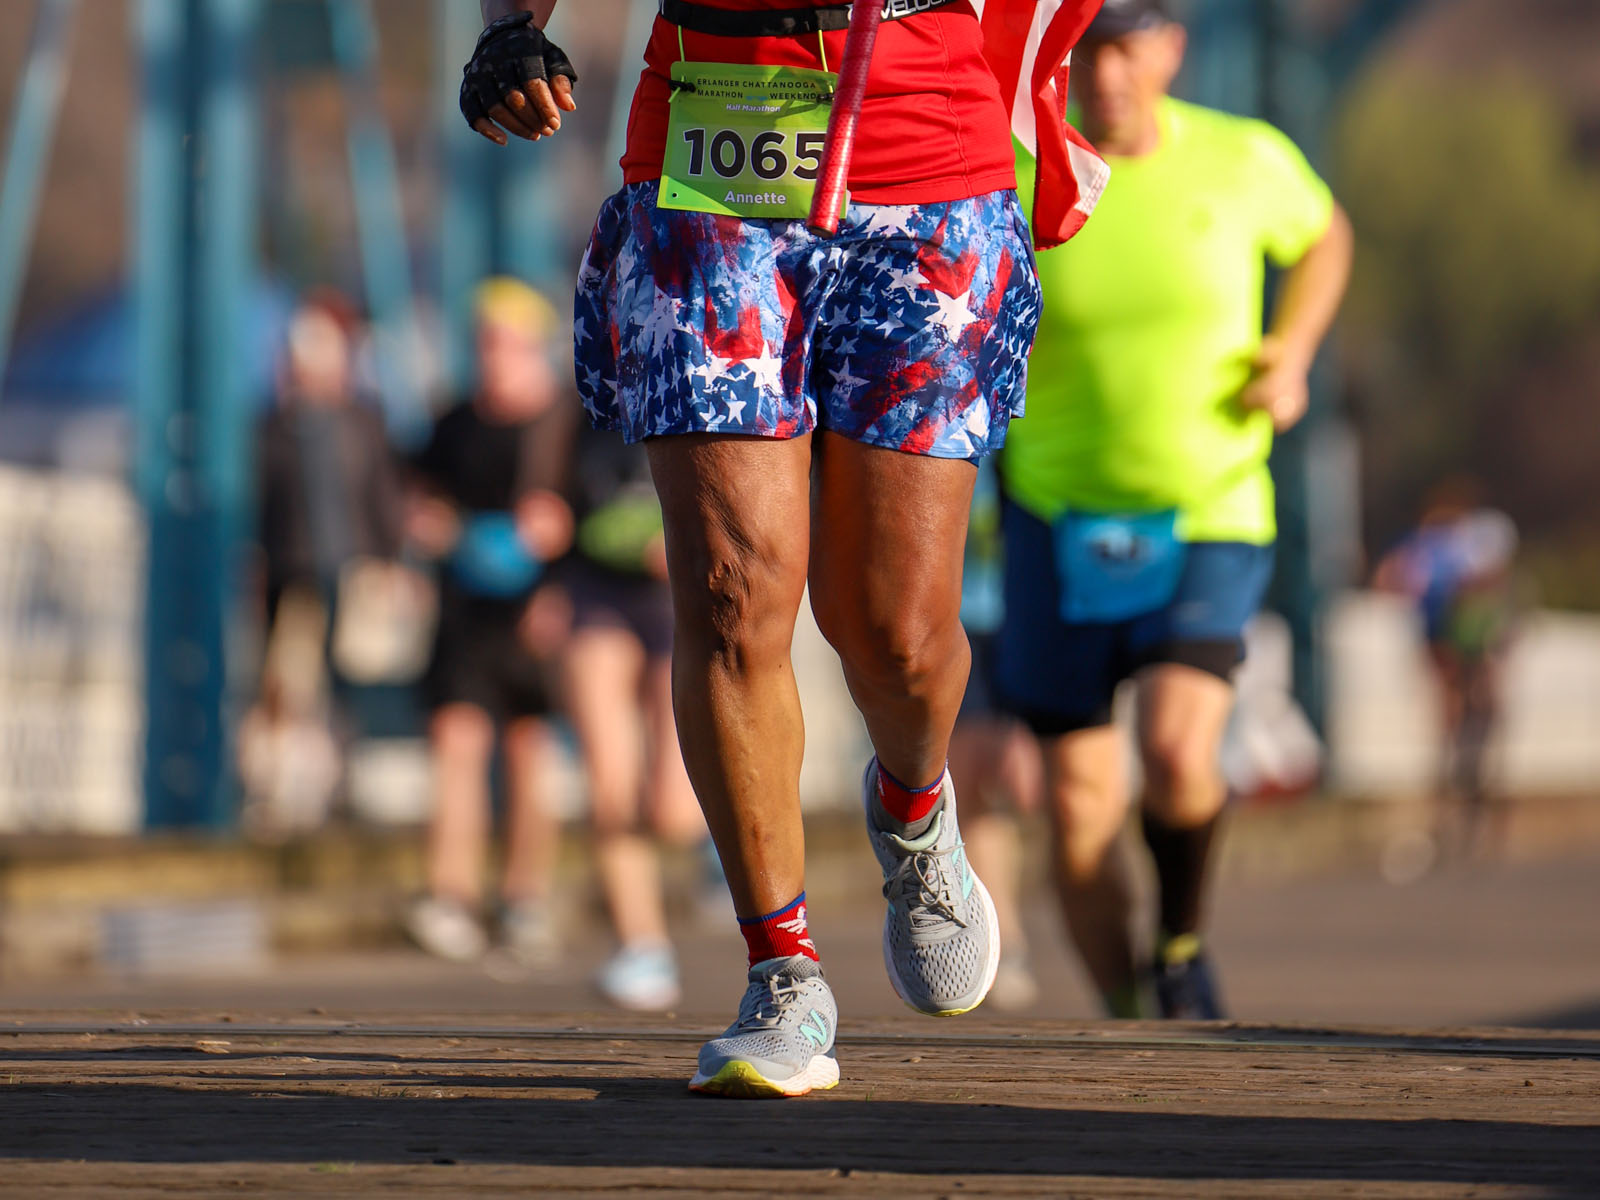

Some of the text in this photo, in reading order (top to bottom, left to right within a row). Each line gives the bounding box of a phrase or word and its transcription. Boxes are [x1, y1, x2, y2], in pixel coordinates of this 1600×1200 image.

[697, 78, 817, 89] ERLANGER CHATTANOOGA
[697, 89, 817, 101] MARATHON WEEKEND
[742, 104, 782, 113] Marathon
[683, 126, 828, 180] 1065
[724, 189, 787, 205] Annette
